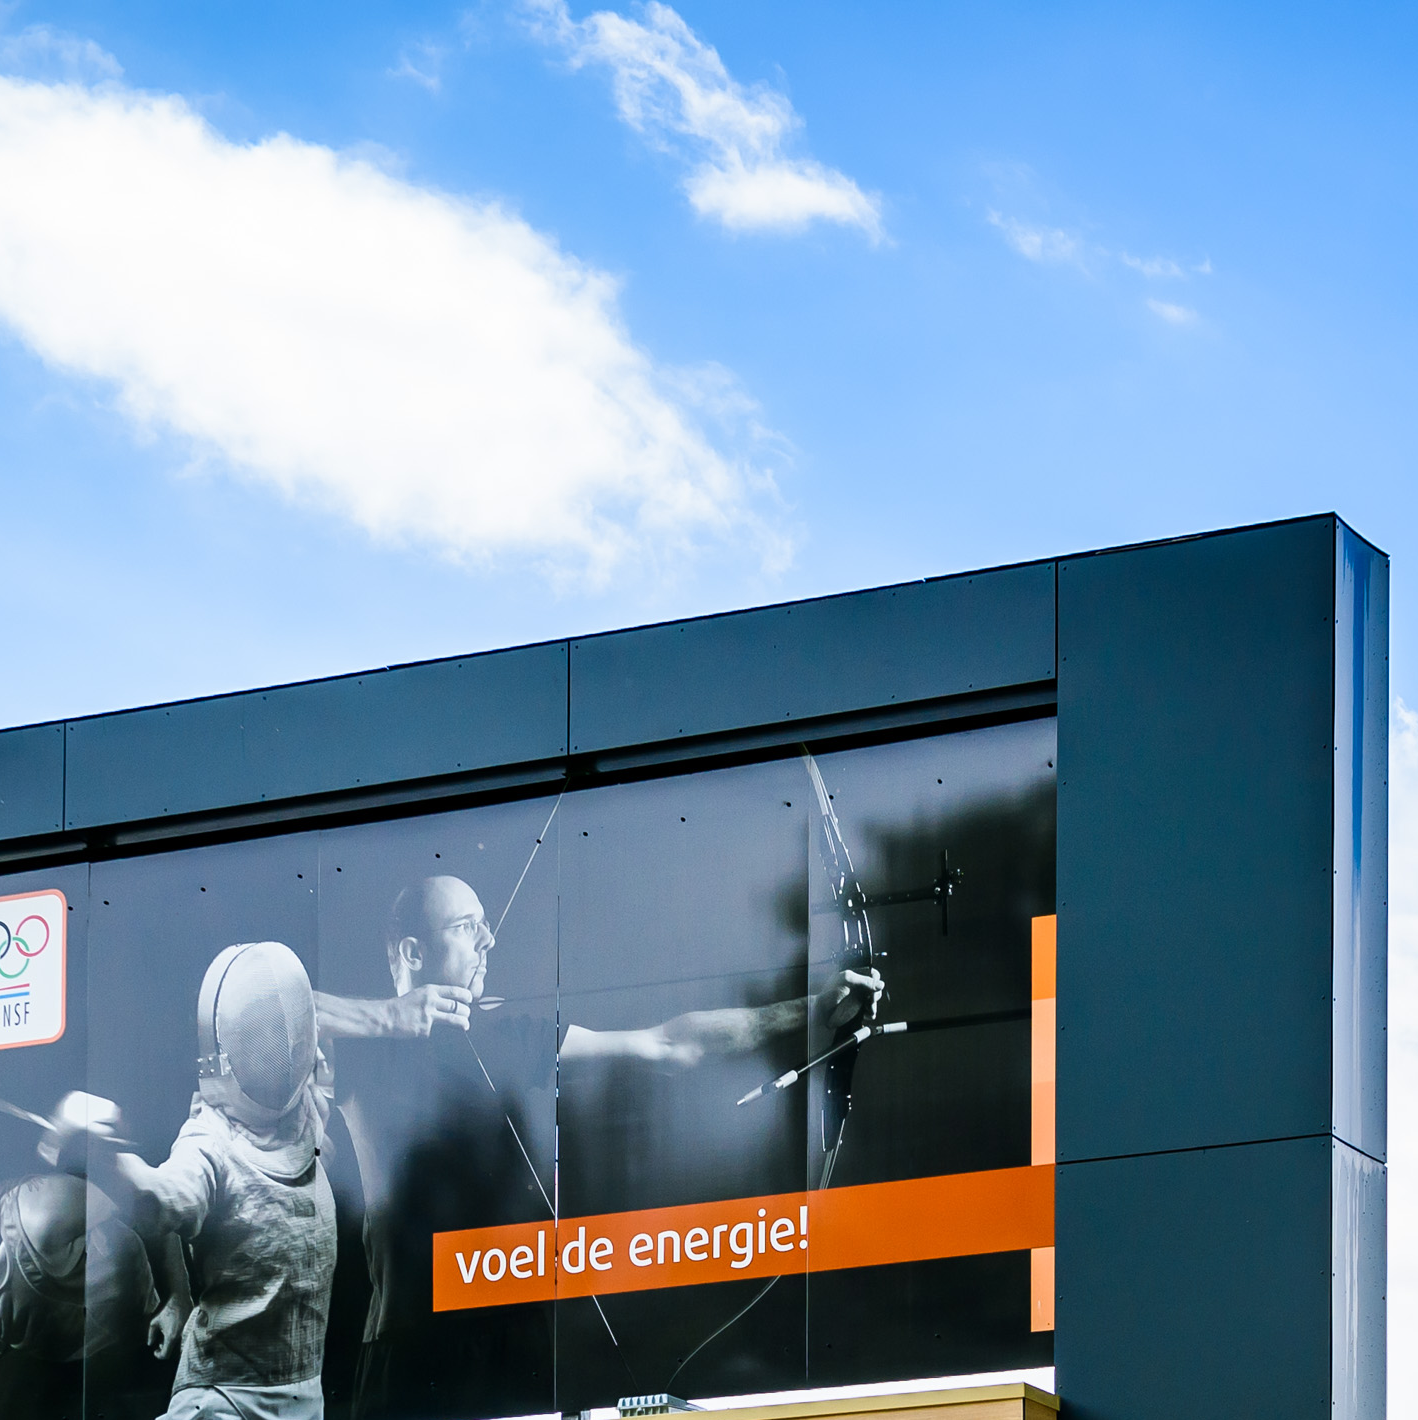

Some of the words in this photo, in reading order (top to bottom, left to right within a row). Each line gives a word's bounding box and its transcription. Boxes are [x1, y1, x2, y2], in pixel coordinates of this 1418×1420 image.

[3, 1001, 30, 1027] NSF
[454, 1230, 546, 1284] voel
[561, 1226, 614, 1274] de
[628, 1205, 809, 1269] energie!
